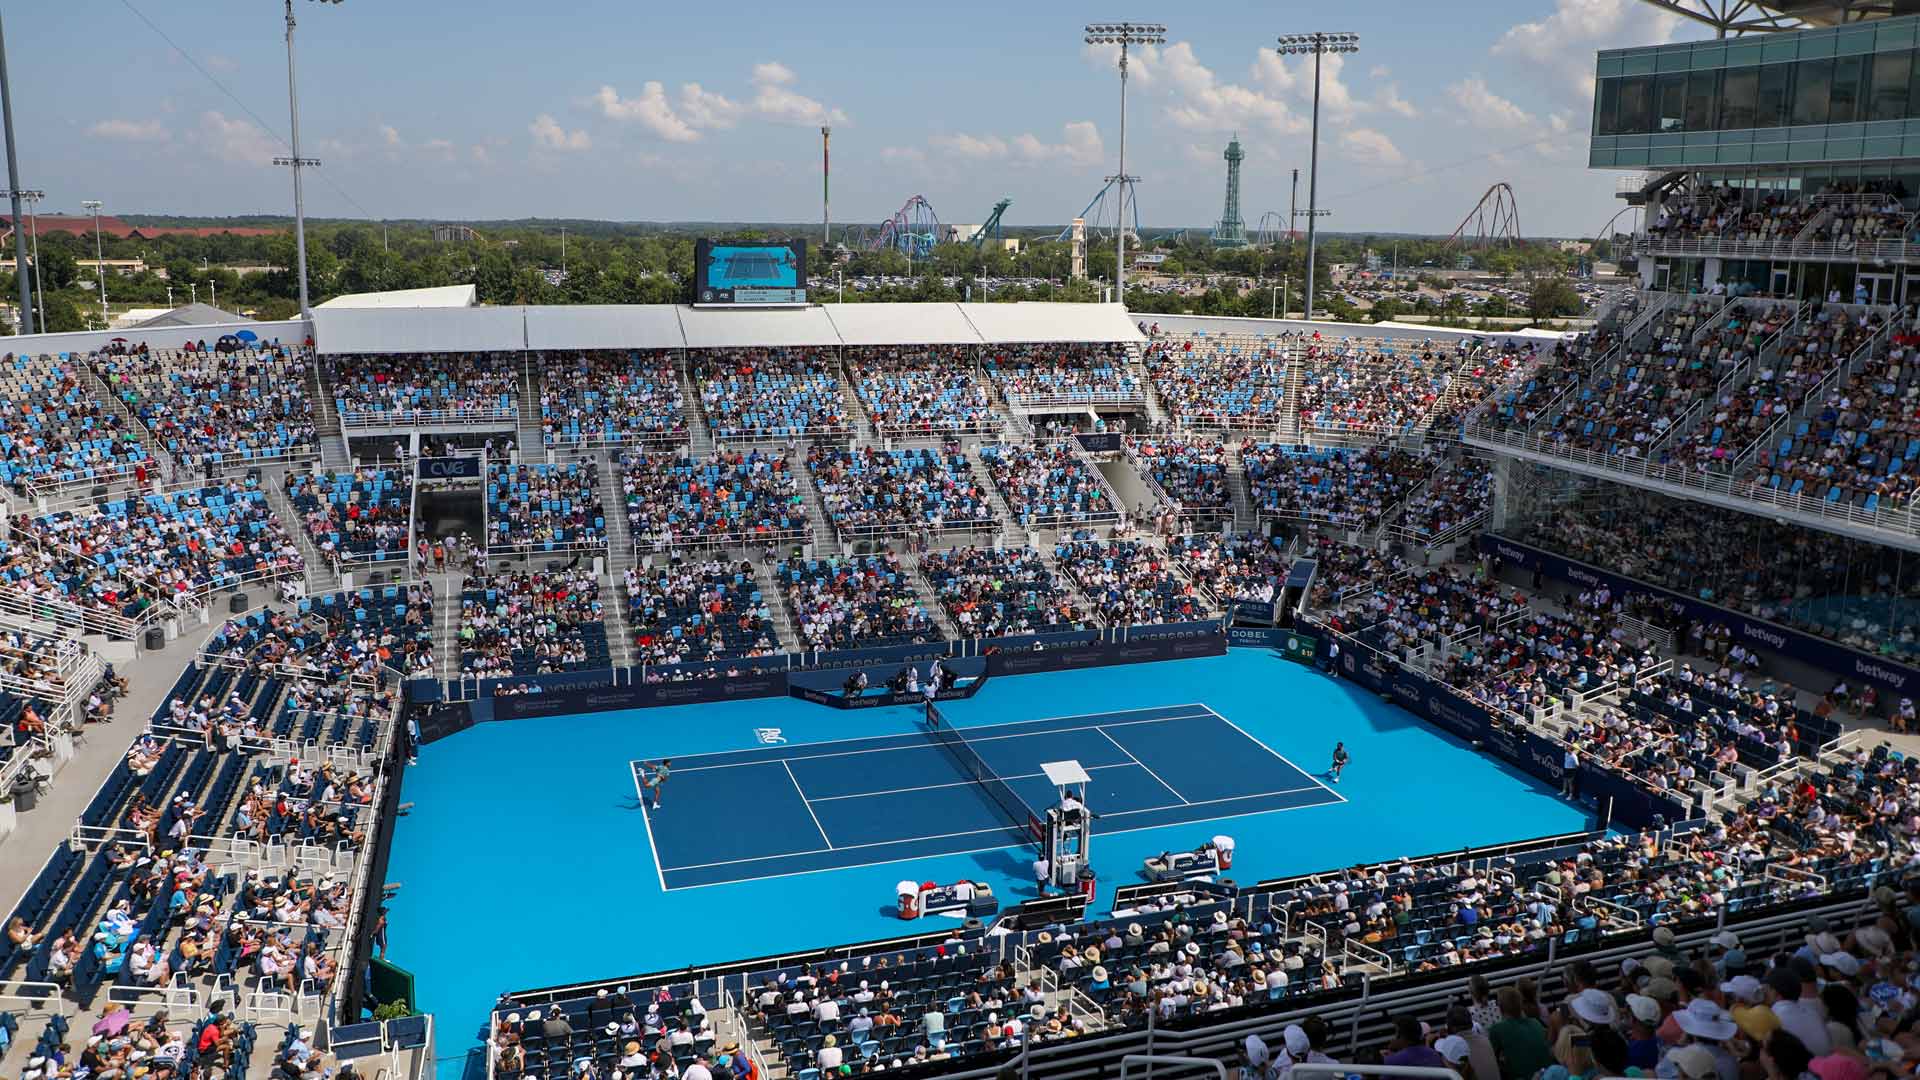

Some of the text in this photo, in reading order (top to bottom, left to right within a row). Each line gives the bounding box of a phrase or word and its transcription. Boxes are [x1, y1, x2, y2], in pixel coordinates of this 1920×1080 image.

[431, 462, 464, 475] CVG
[1497, 543, 1525, 562] betway
[1567, 565, 1600, 586] betway
[1231, 630, 1269, 638] DOBEL
[1744, 623, 1786, 649] betway
[1855, 658, 1905, 688] betway
[850, 696, 879, 706] betway
[894, 693, 922, 703] betway
